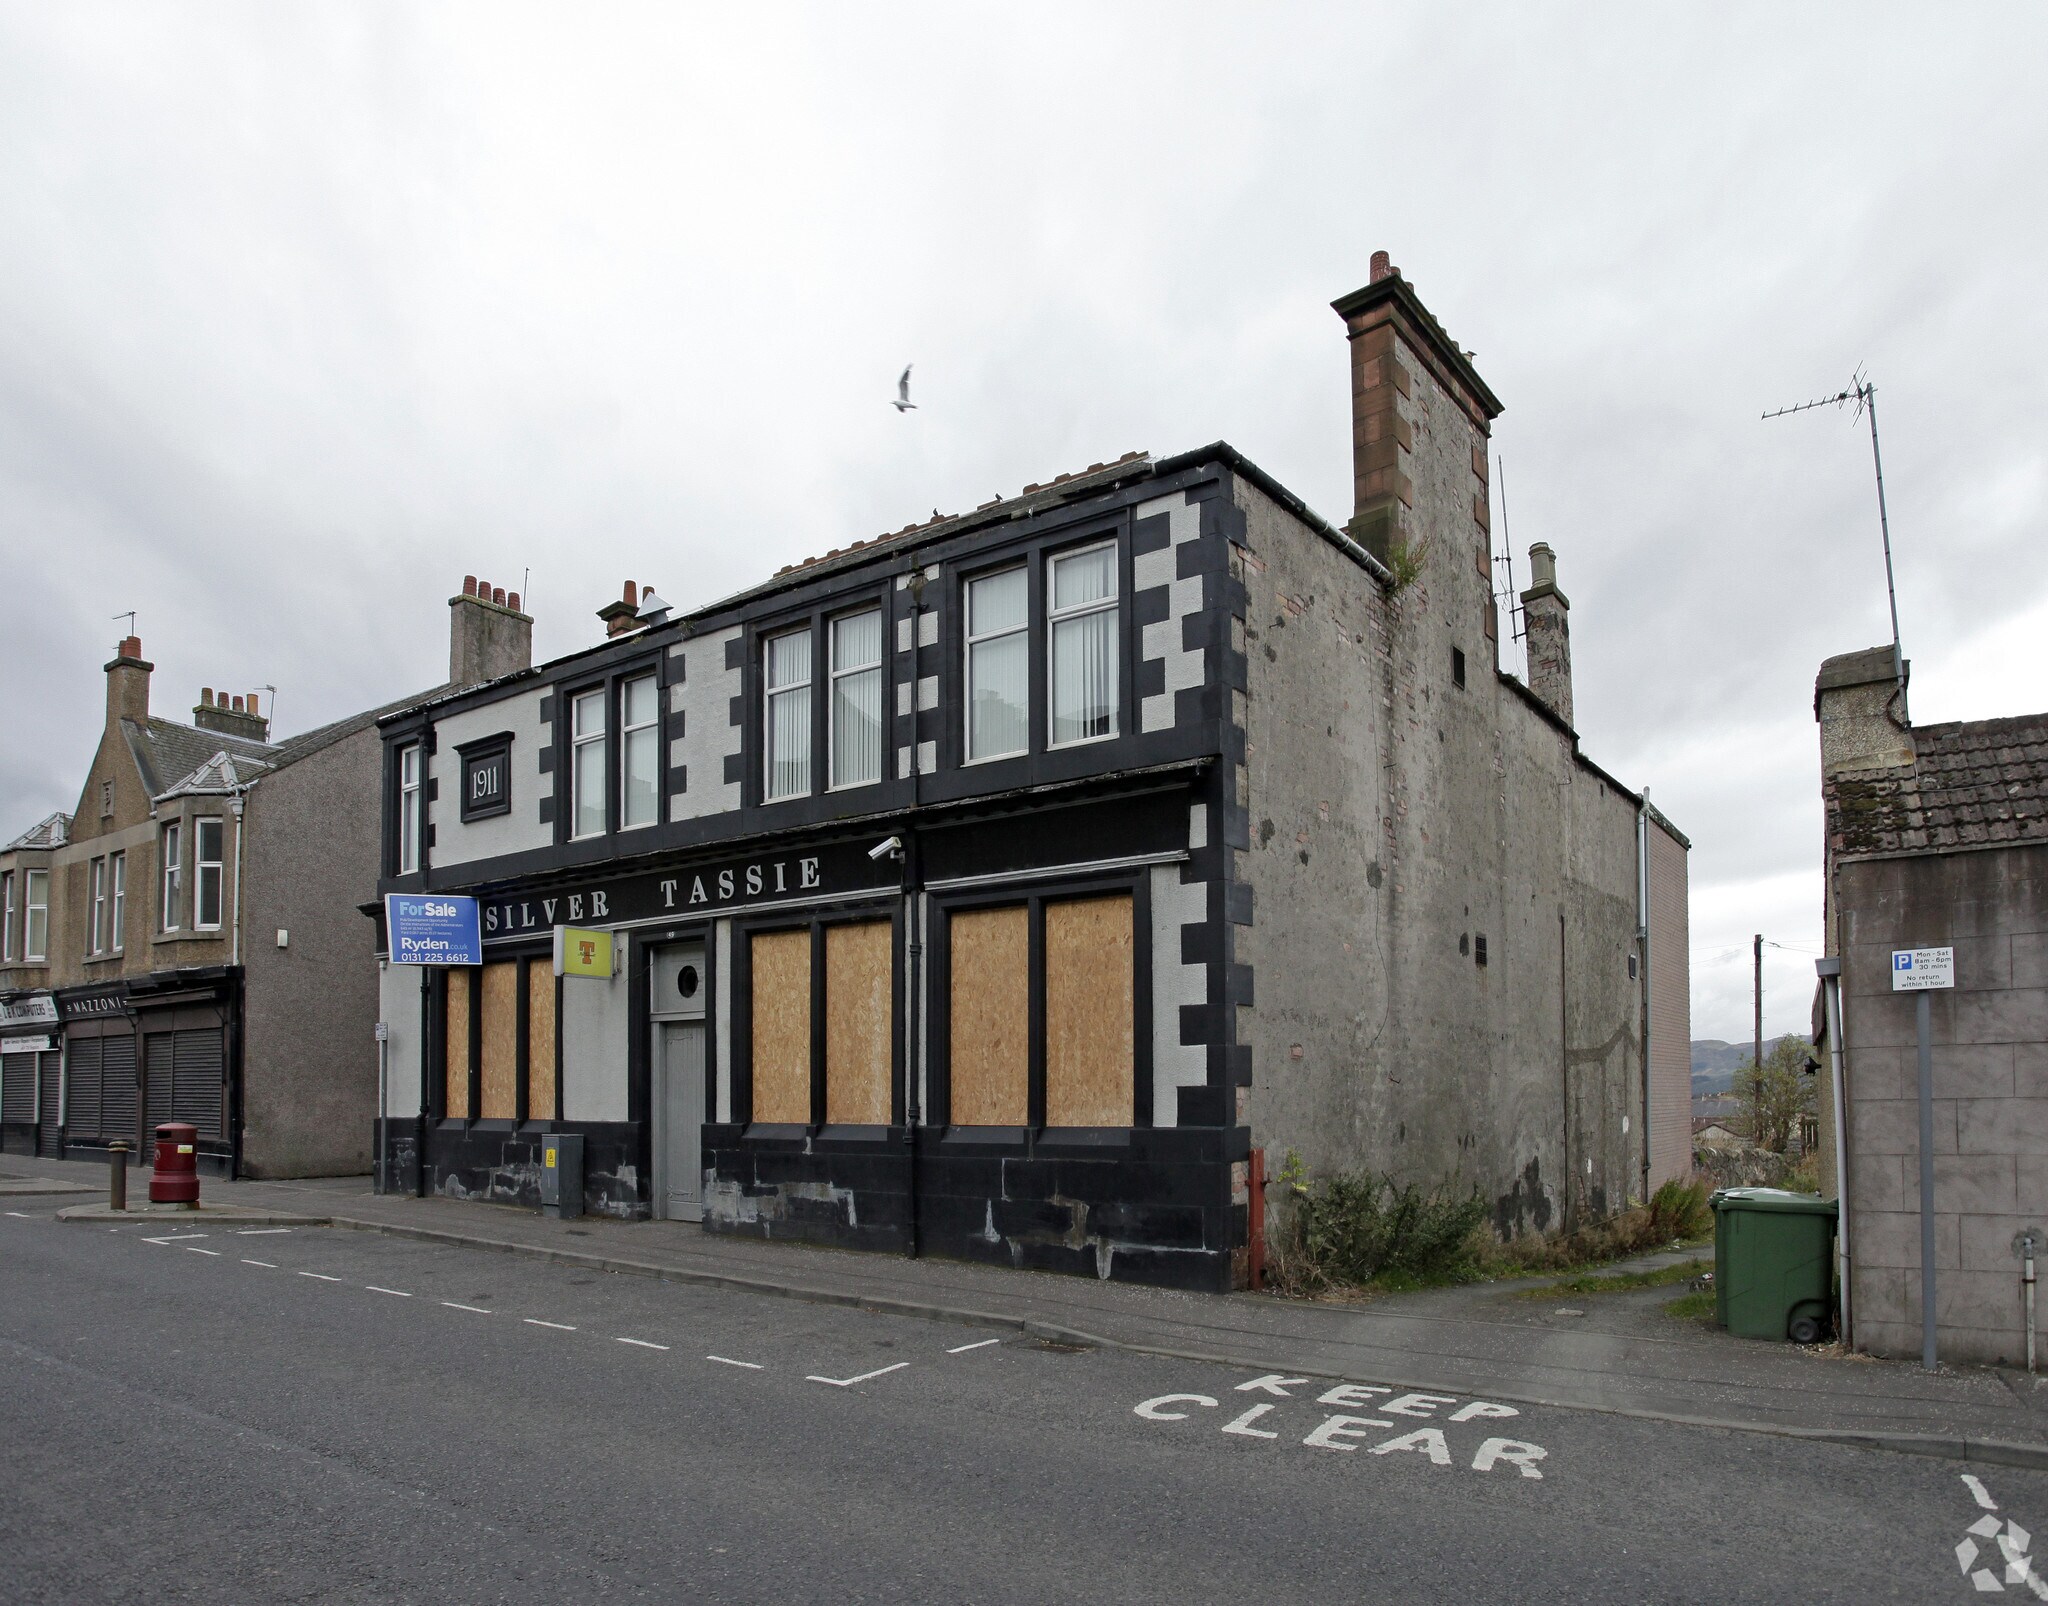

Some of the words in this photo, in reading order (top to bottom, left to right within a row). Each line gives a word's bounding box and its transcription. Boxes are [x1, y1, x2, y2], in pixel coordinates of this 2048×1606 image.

[473, 766, 498, 799] 1911
[485, 891, 610, 931] SILVER
[660, 857, 821, 908] TASSIE
[401, 953, 421, 962] 0131
[424, 953, 443, 962] 225
[446, 953, 469, 962] 6612
[1898, 955, 1909, 969] P
[16, 1003, 46, 1017] COMPUTERS
[73, 996, 122, 1013] MAZZONI
[1233, 1374, 1520, 1422] KEEP
[1133, 1392, 1549, 1480] CLEAR
